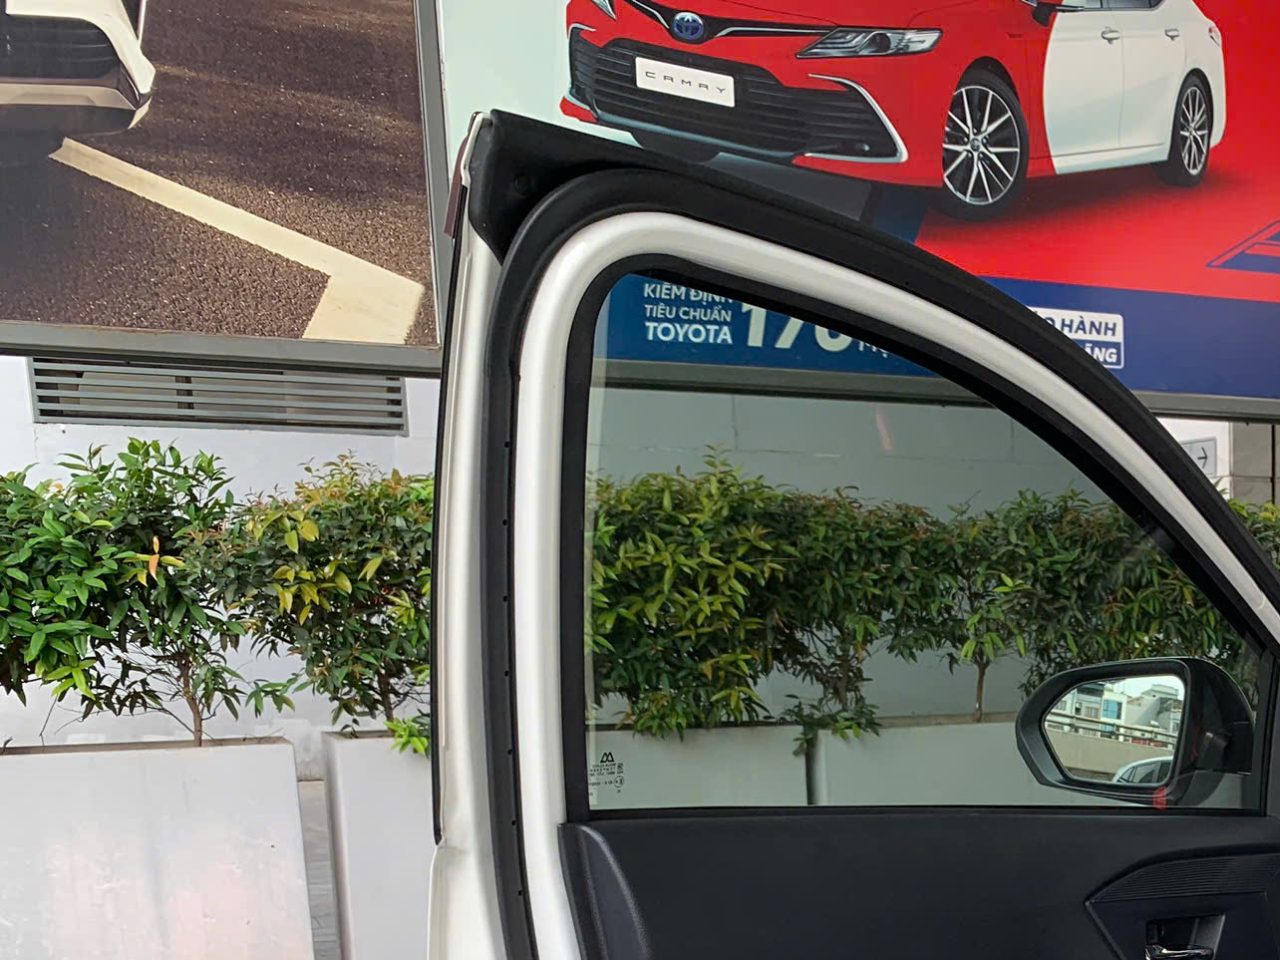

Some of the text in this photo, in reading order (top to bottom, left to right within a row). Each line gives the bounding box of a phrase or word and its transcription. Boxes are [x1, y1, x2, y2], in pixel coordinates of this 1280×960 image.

[645, 71, 726, 94] CAMRY
[644, 302, 732, 323] TIÊU CHUẨN
[645, 321, 734, 345] TOYOTA
[1060, 315, 1117, 337] HÀNH
